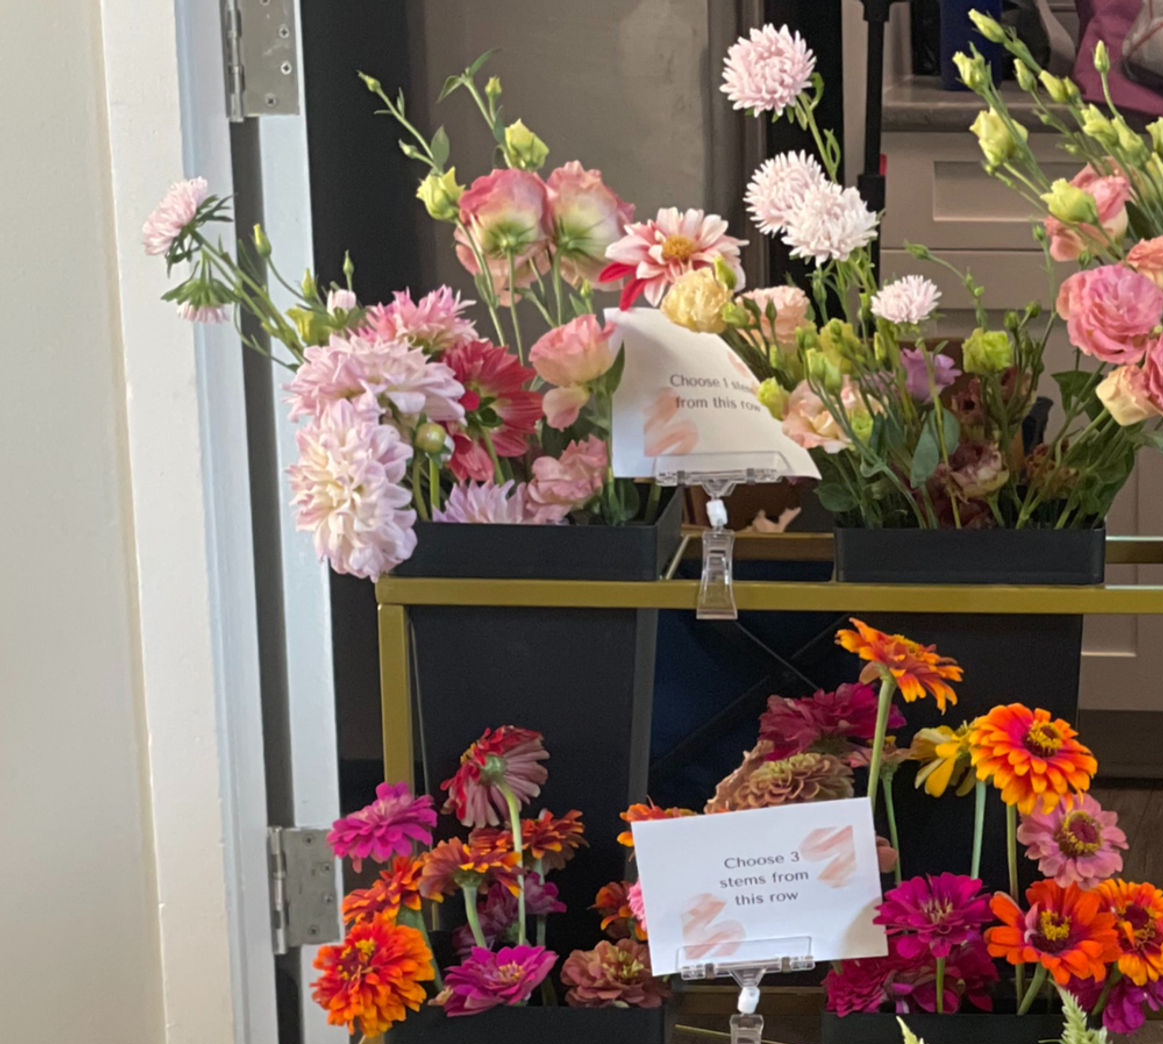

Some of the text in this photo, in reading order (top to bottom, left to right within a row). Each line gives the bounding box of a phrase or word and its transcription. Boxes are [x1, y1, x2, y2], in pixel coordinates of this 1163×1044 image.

[670, 374, 720, 388] Choose
[675, 396, 708, 410] from
[713, 396, 737, 410] this
[723, 850, 801, 870] Choose 3
[719, 869, 809, 889] stems from
[735, 891, 800, 907] this row
